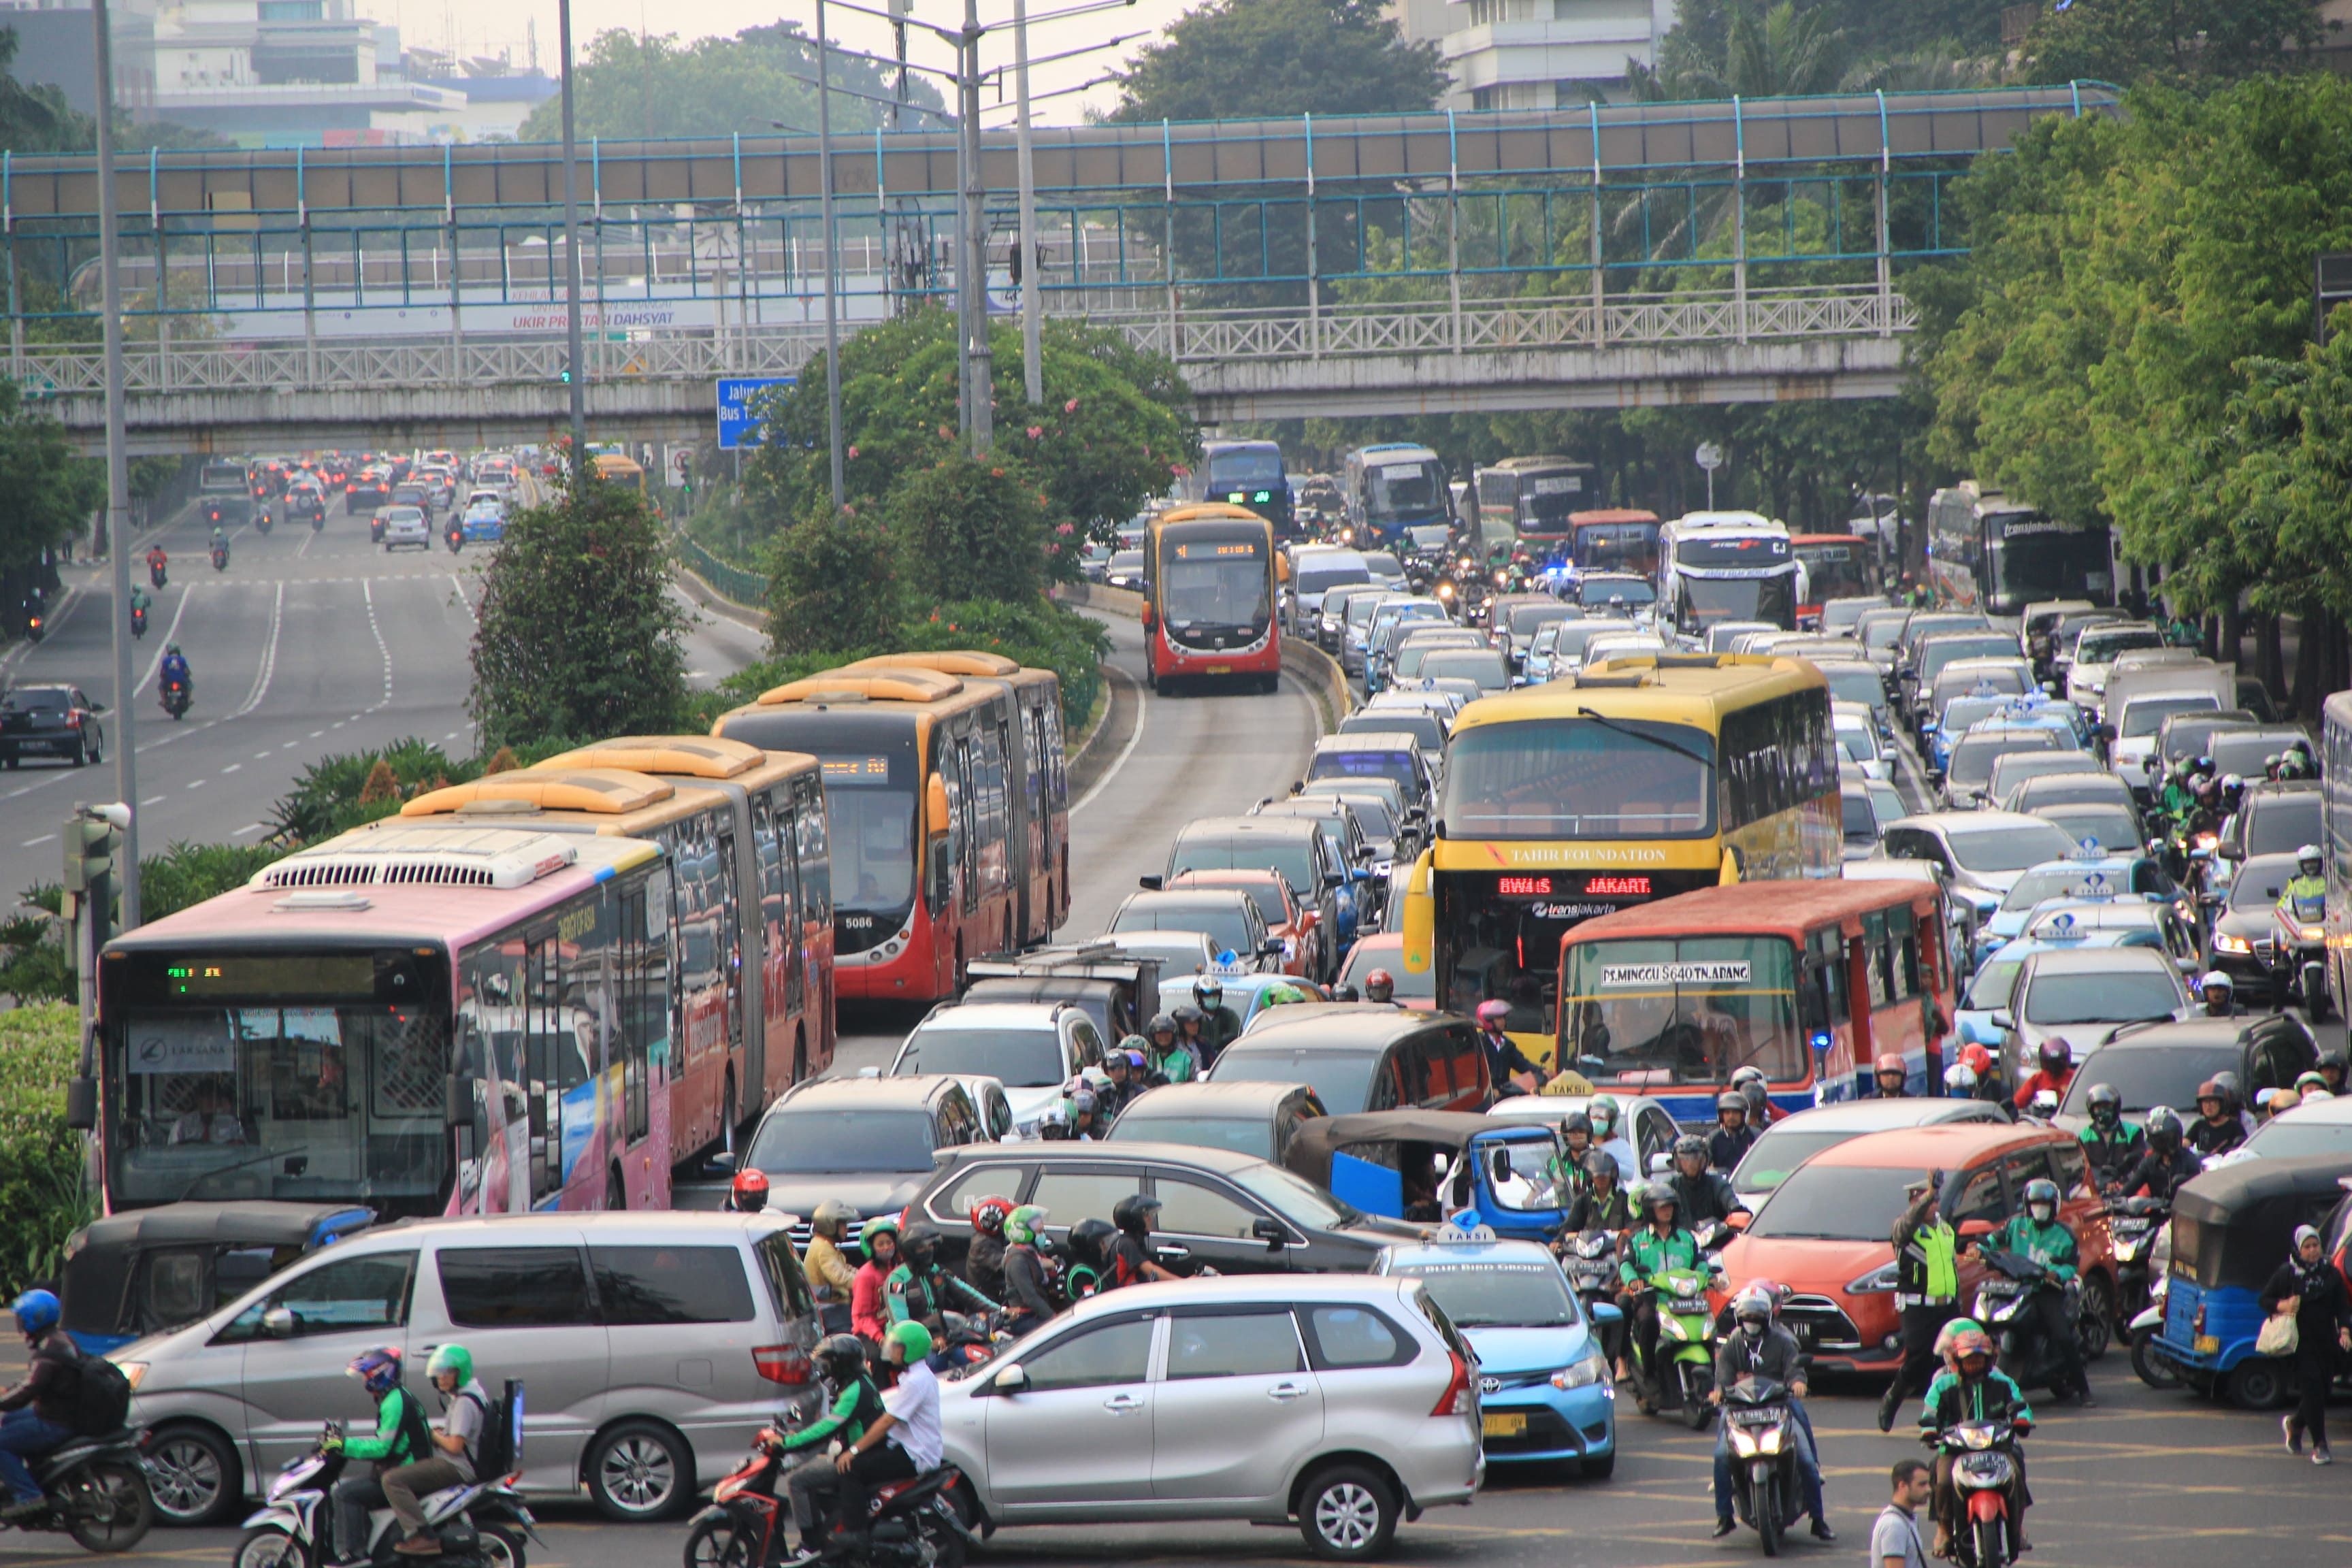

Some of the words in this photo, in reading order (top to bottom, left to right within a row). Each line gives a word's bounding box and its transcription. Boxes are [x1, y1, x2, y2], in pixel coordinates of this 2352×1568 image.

[512, 315, 545, 328] UKIR
[614, 312, 674, 325] DAHSYAT
[720, 406, 739, 421] Bus
[1511, 849, 1559, 862] TAHIR
[1564, 848, 1667, 861] FOUNDATION
[1448, 1232, 1487, 1241] TAKSI
[1793, 1322, 1810, 1336] VIN
